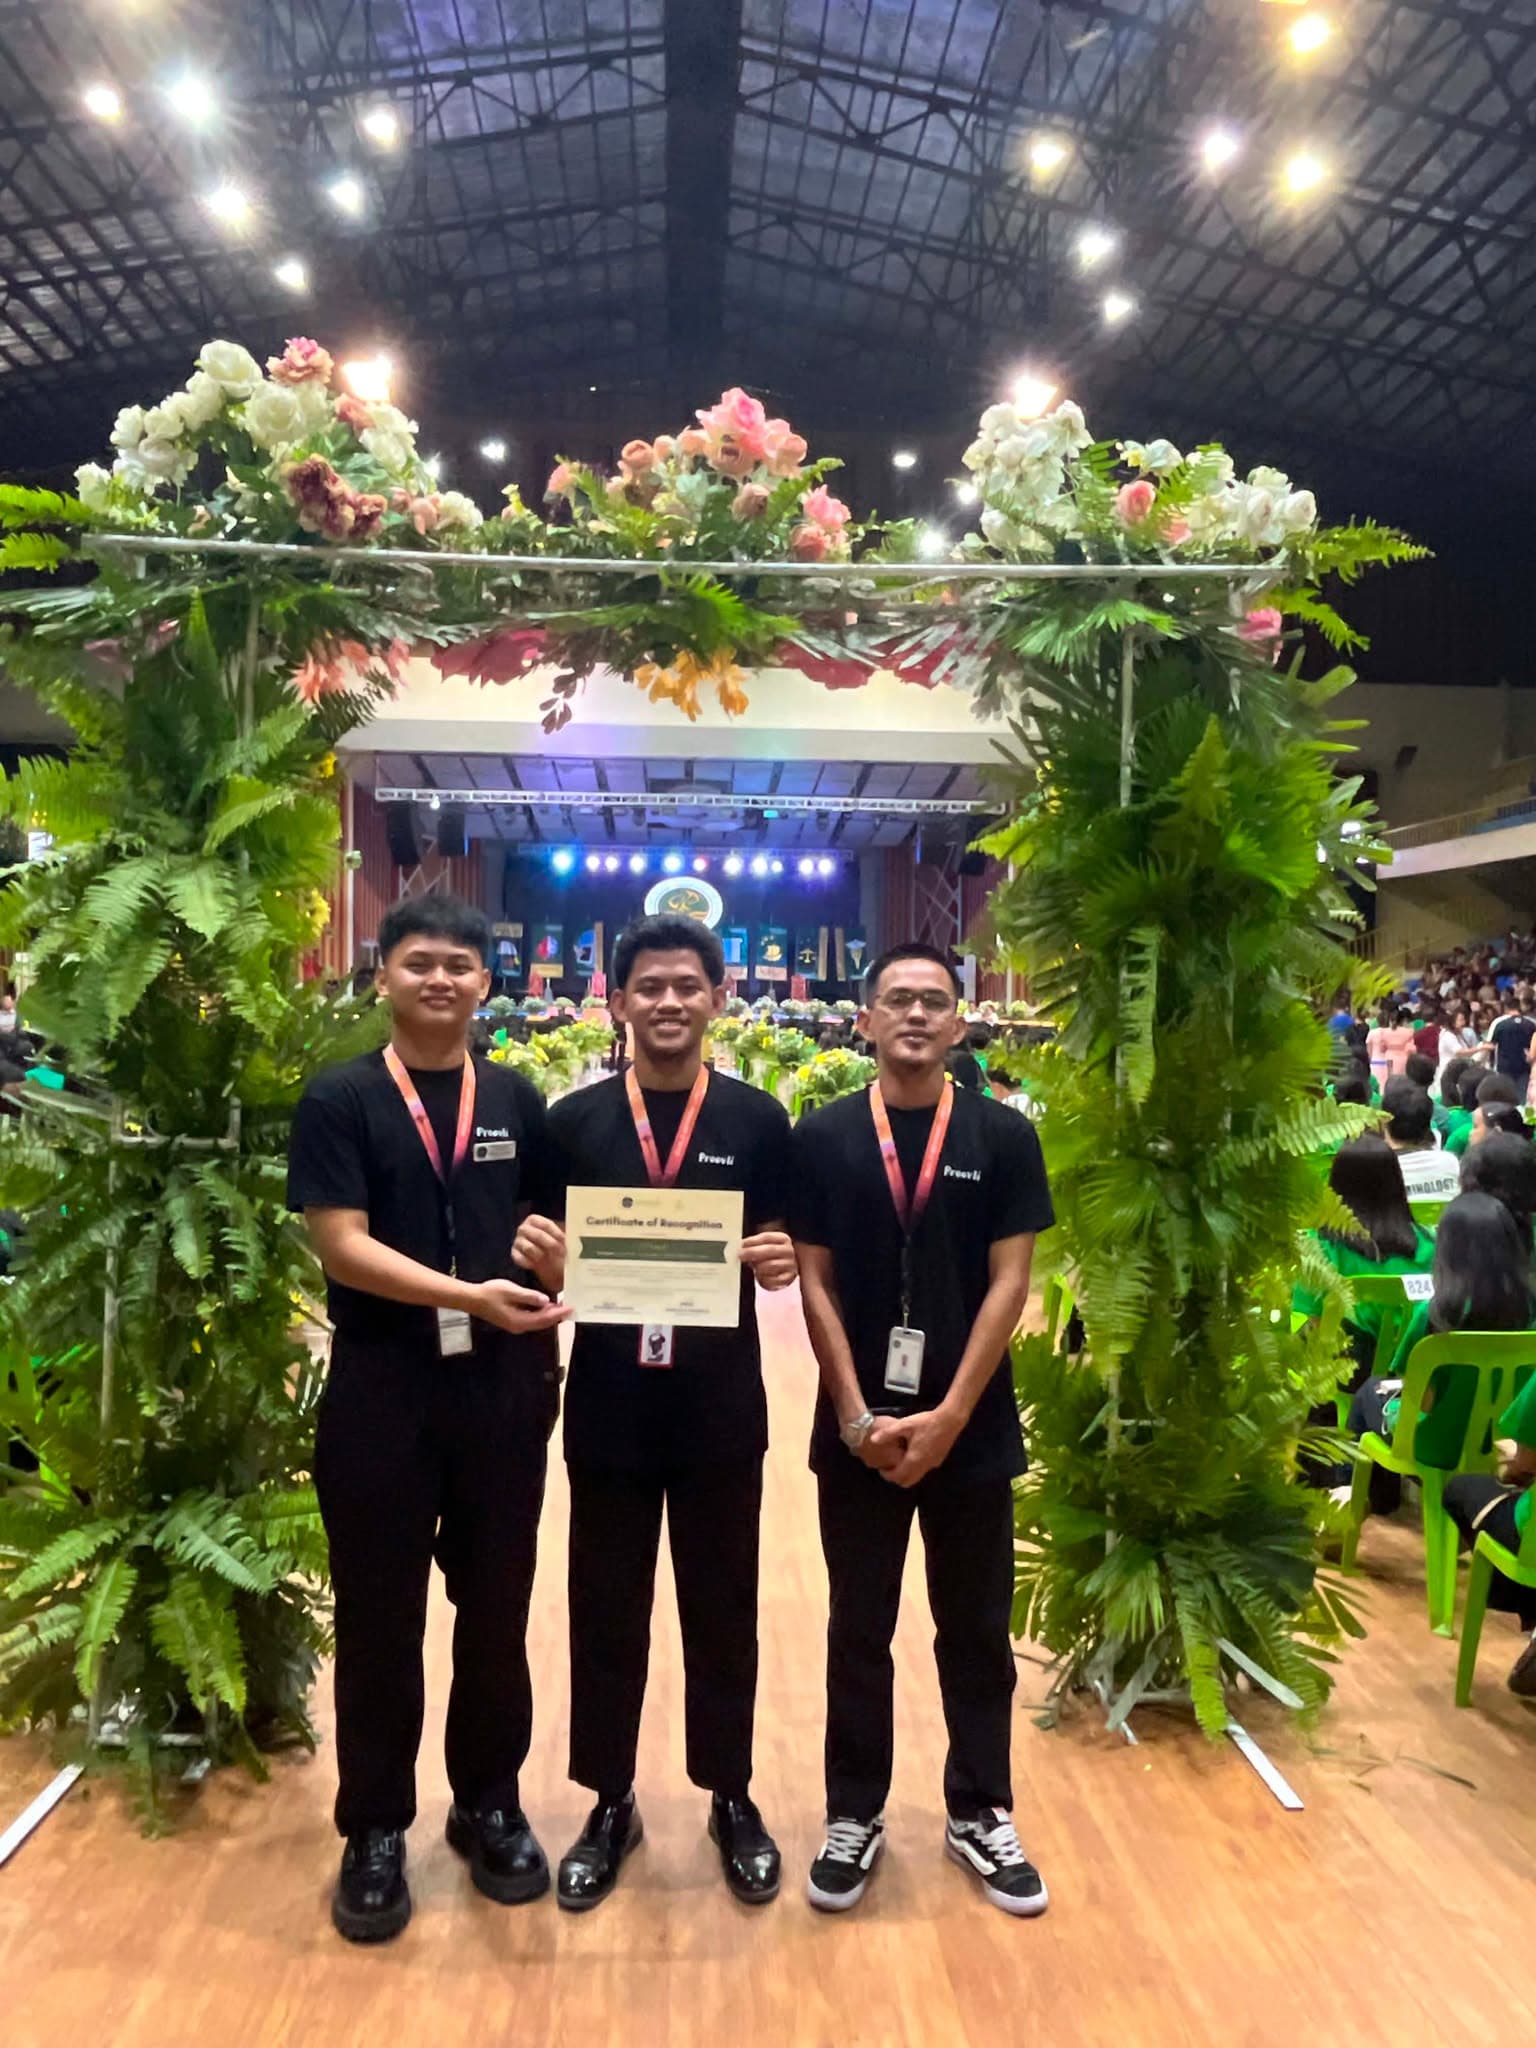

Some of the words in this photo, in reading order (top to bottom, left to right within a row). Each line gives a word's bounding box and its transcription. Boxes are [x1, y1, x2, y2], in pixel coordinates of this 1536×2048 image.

[586, 1216, 644, 1227] Certificate
[646, 1217, 658, 1227] of
[660, 1218, 722, 1229] Recognition
